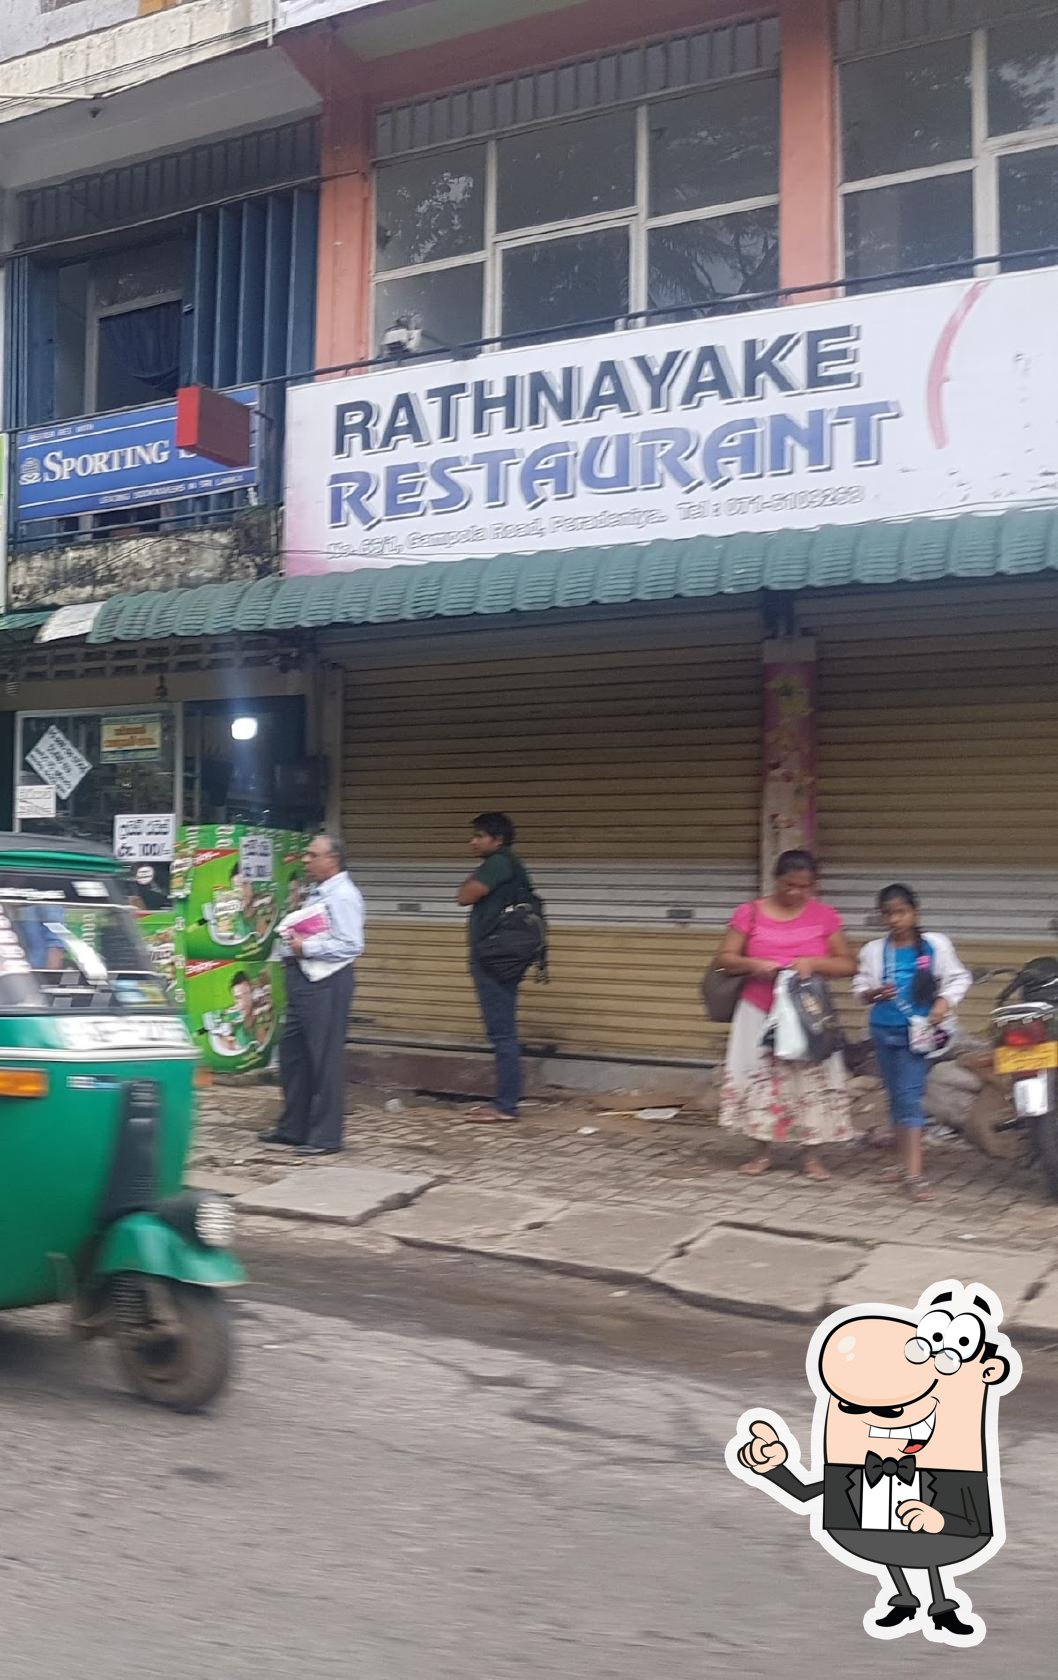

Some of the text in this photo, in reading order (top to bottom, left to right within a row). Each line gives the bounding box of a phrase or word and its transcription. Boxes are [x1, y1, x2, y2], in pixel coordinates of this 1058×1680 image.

[334, 324, 862, 459] RATHNAYAKE
[43, 440, 169, 483] SPORTING
[328, 400, 902, 531] RESTAURANT
